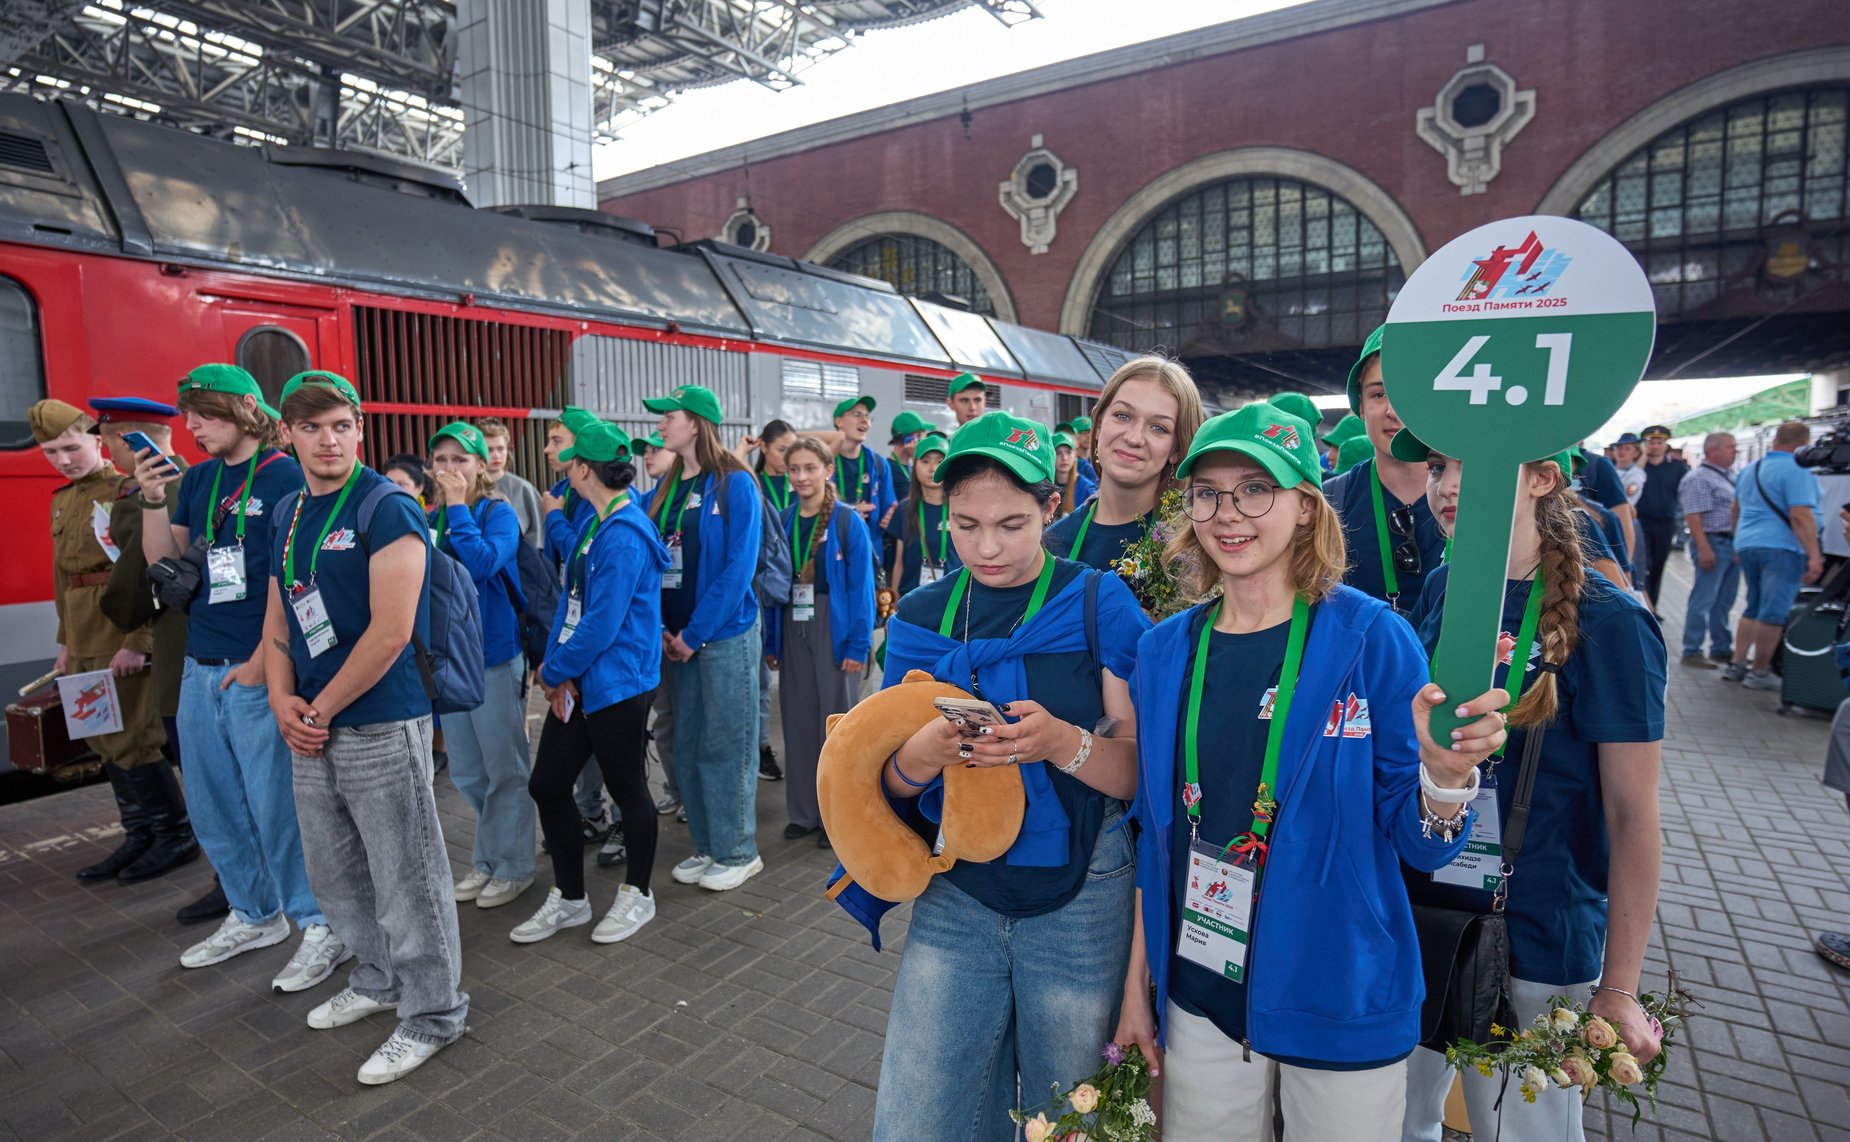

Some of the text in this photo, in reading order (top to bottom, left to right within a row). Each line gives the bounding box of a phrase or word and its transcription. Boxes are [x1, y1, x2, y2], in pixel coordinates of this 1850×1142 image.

[1442, 297, 1568, 313] Поезд Памяти 2025
[1433, 332, 1573, 406] 4.1
[1464, 843, 1487, 851] СТНИК
[1187, 925, 1209, 939] Ускова
[1197, 914, 1234, 936] УЧАСТНИК
[1186, 933, 1207, 946] Мария
[1228, 964, 1238, 973] 4.1
